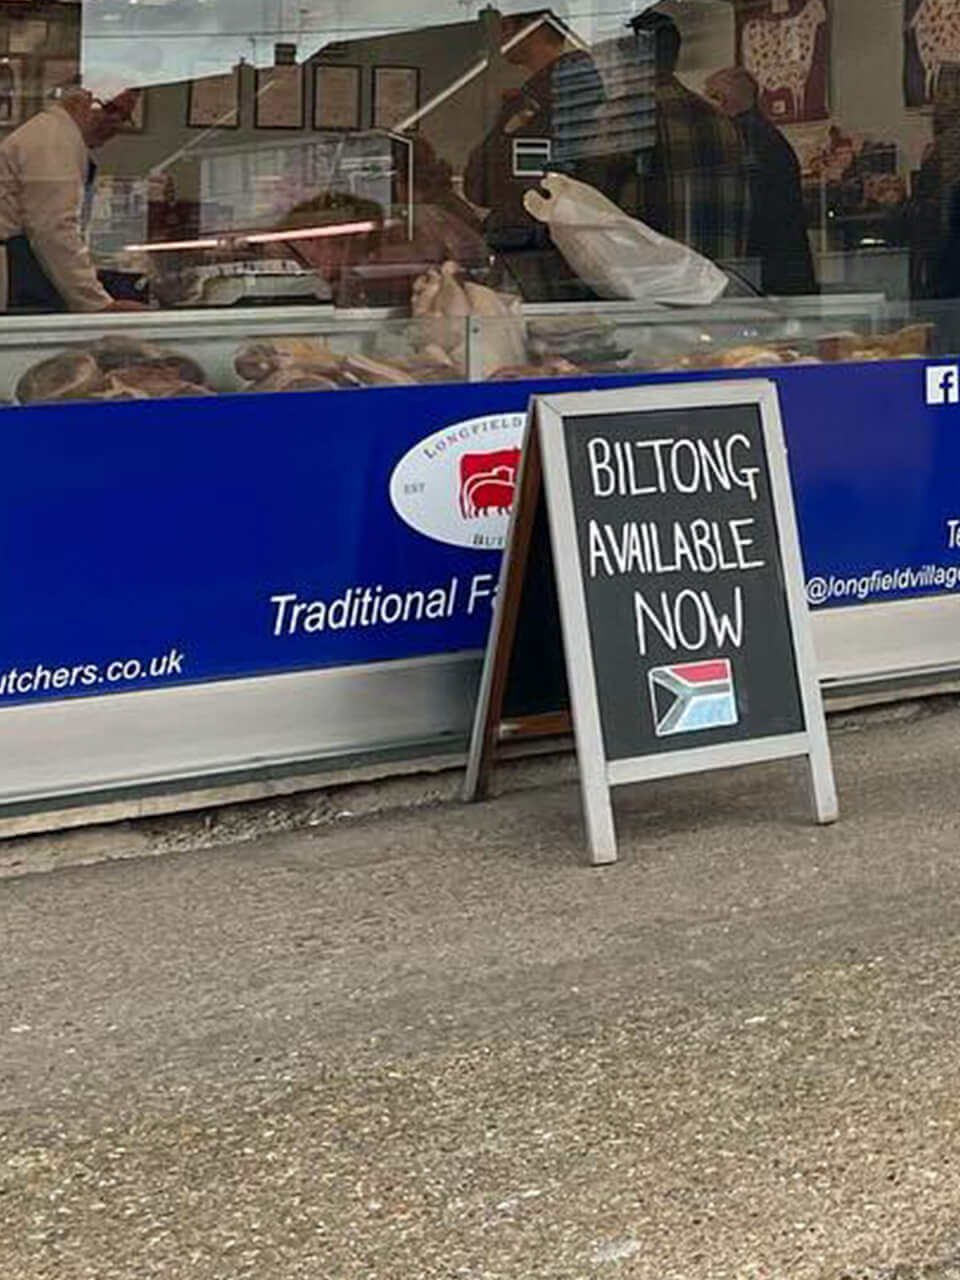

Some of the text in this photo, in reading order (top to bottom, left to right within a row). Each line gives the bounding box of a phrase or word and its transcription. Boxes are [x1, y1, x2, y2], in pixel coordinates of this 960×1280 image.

[423, 416, 523, 460] LONGFIELD
[587, 434, 760, 501] BILTONG
[404, 482, 425, 495] EST
[589, 518, 765, 577] AVAILABLE
[269, 577, 458, 637] Traditional
[634, 585, 743, 656] NOW
